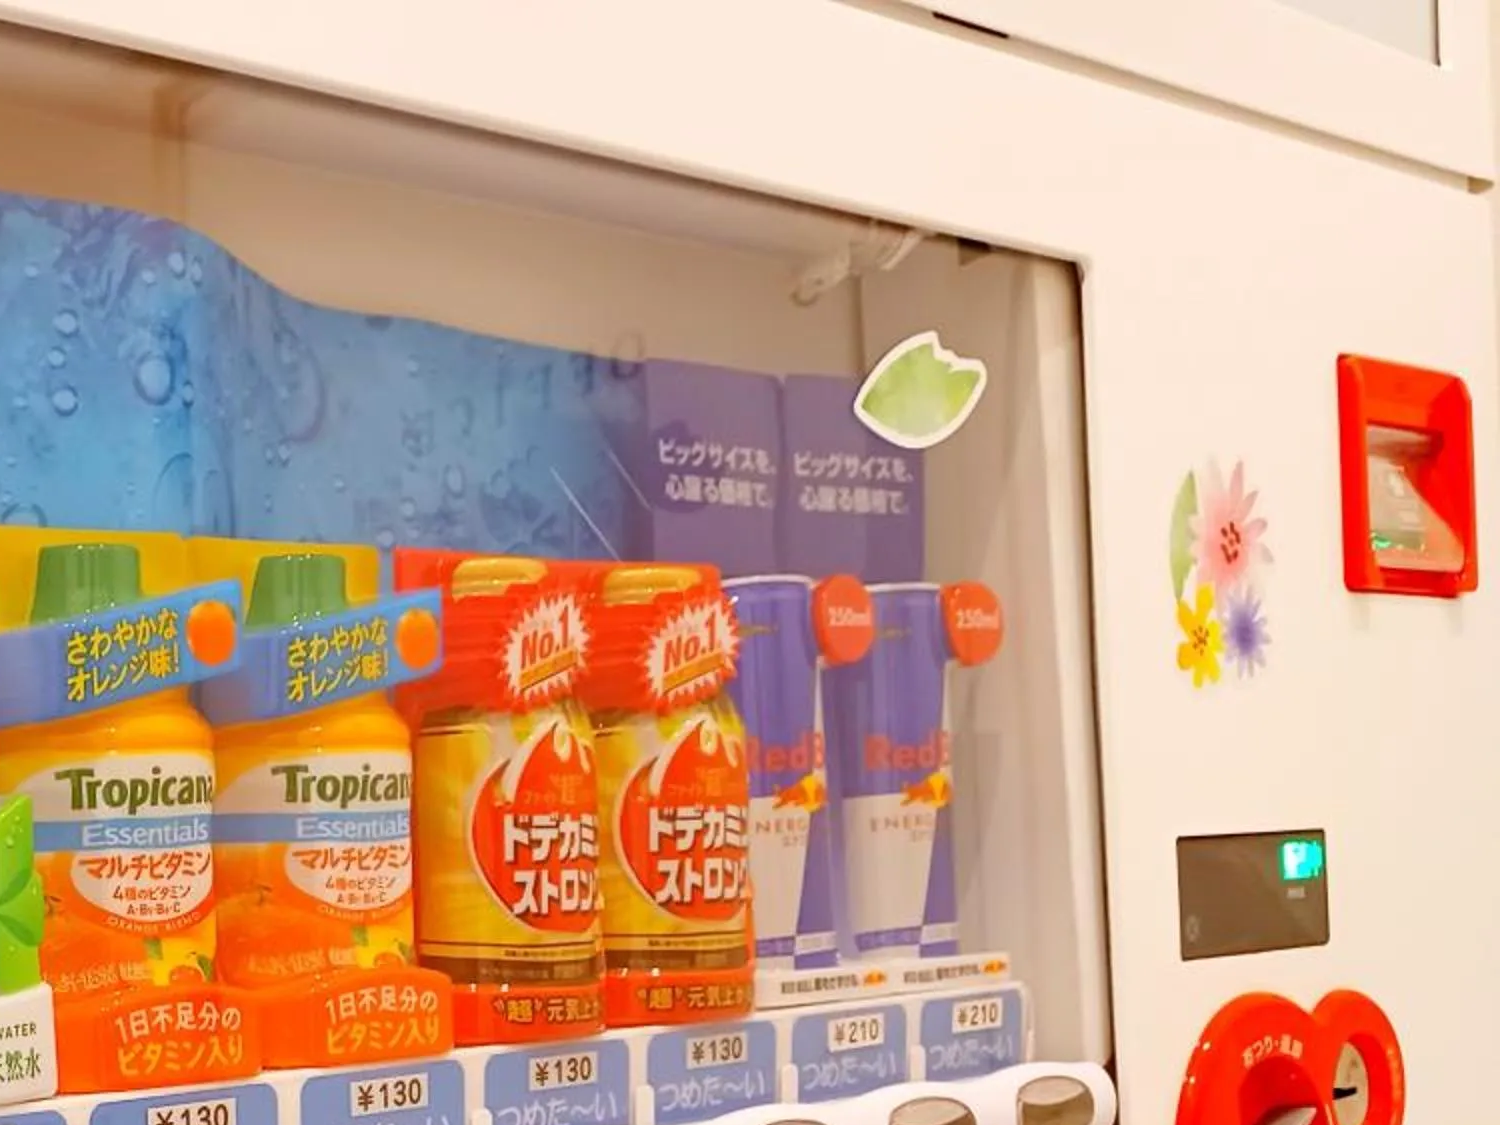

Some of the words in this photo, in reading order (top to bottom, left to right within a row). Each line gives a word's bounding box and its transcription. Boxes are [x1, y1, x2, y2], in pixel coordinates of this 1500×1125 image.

[67, 608, 178, 667] さわやかな
[287, 617, 388, 669] さわやかな
[82, 817, 210, 848] Essentials
[78, 850, 211, 880] マルチビタミン
[115, 1001, 242, 1043] 1日不足分の
[325, 985, 439, 1024] 1日不足分の
[327, 1016, 440, 1055] ビタミン入り
[691, 1037, 743, 1064] ¥130
[117, 1035, 244, 1077] ビタミン入り
[534, 1055, 592, 1086] ¥130
[357, 1078, 422, 1112] ¥130
